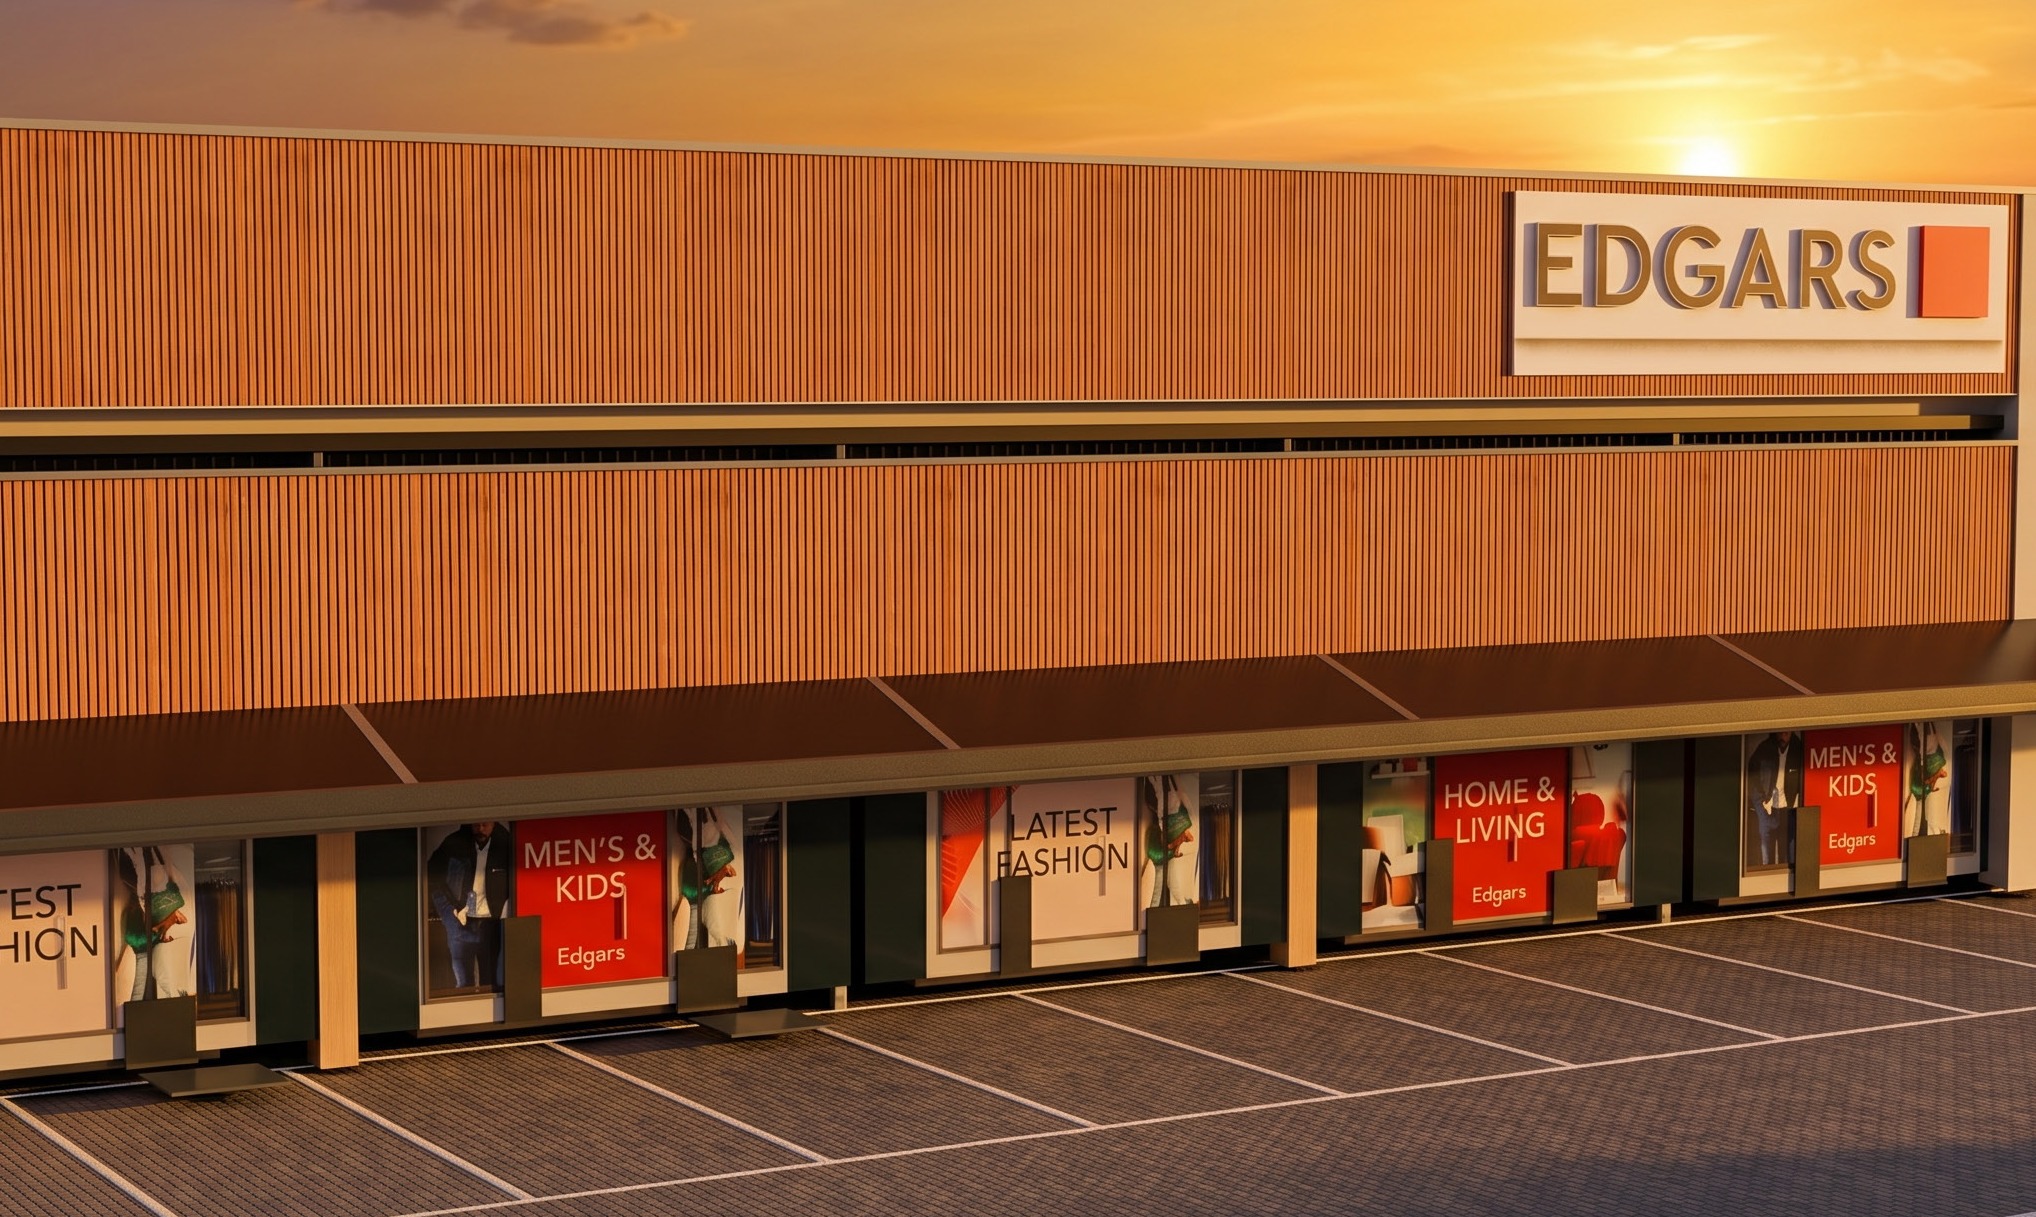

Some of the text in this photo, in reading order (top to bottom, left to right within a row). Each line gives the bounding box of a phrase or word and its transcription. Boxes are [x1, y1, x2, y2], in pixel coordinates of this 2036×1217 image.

[1525, 222, 1897, 311] EDGARS
[1810, 742, 1896, 768] MEN'S &
[1445, 776, 1556, 809] HOME &
[1829, 773, 1877, 798] KIDS
[1011, 807, 1117, 841] LATEST
[1456, 811, 1545, 844] LIVING
[525, 833, 656, 869] MEN'S &
[1829, 832, 1876, 854] Edgars
[997, 842, 1128, 879] FASHION
[0, 884, 81, 920] EST
[556, 871, 626, 902] KIDS
[1472, 885, 1526, 907] Edgars
[558, 946, 625, 970] Edgars
